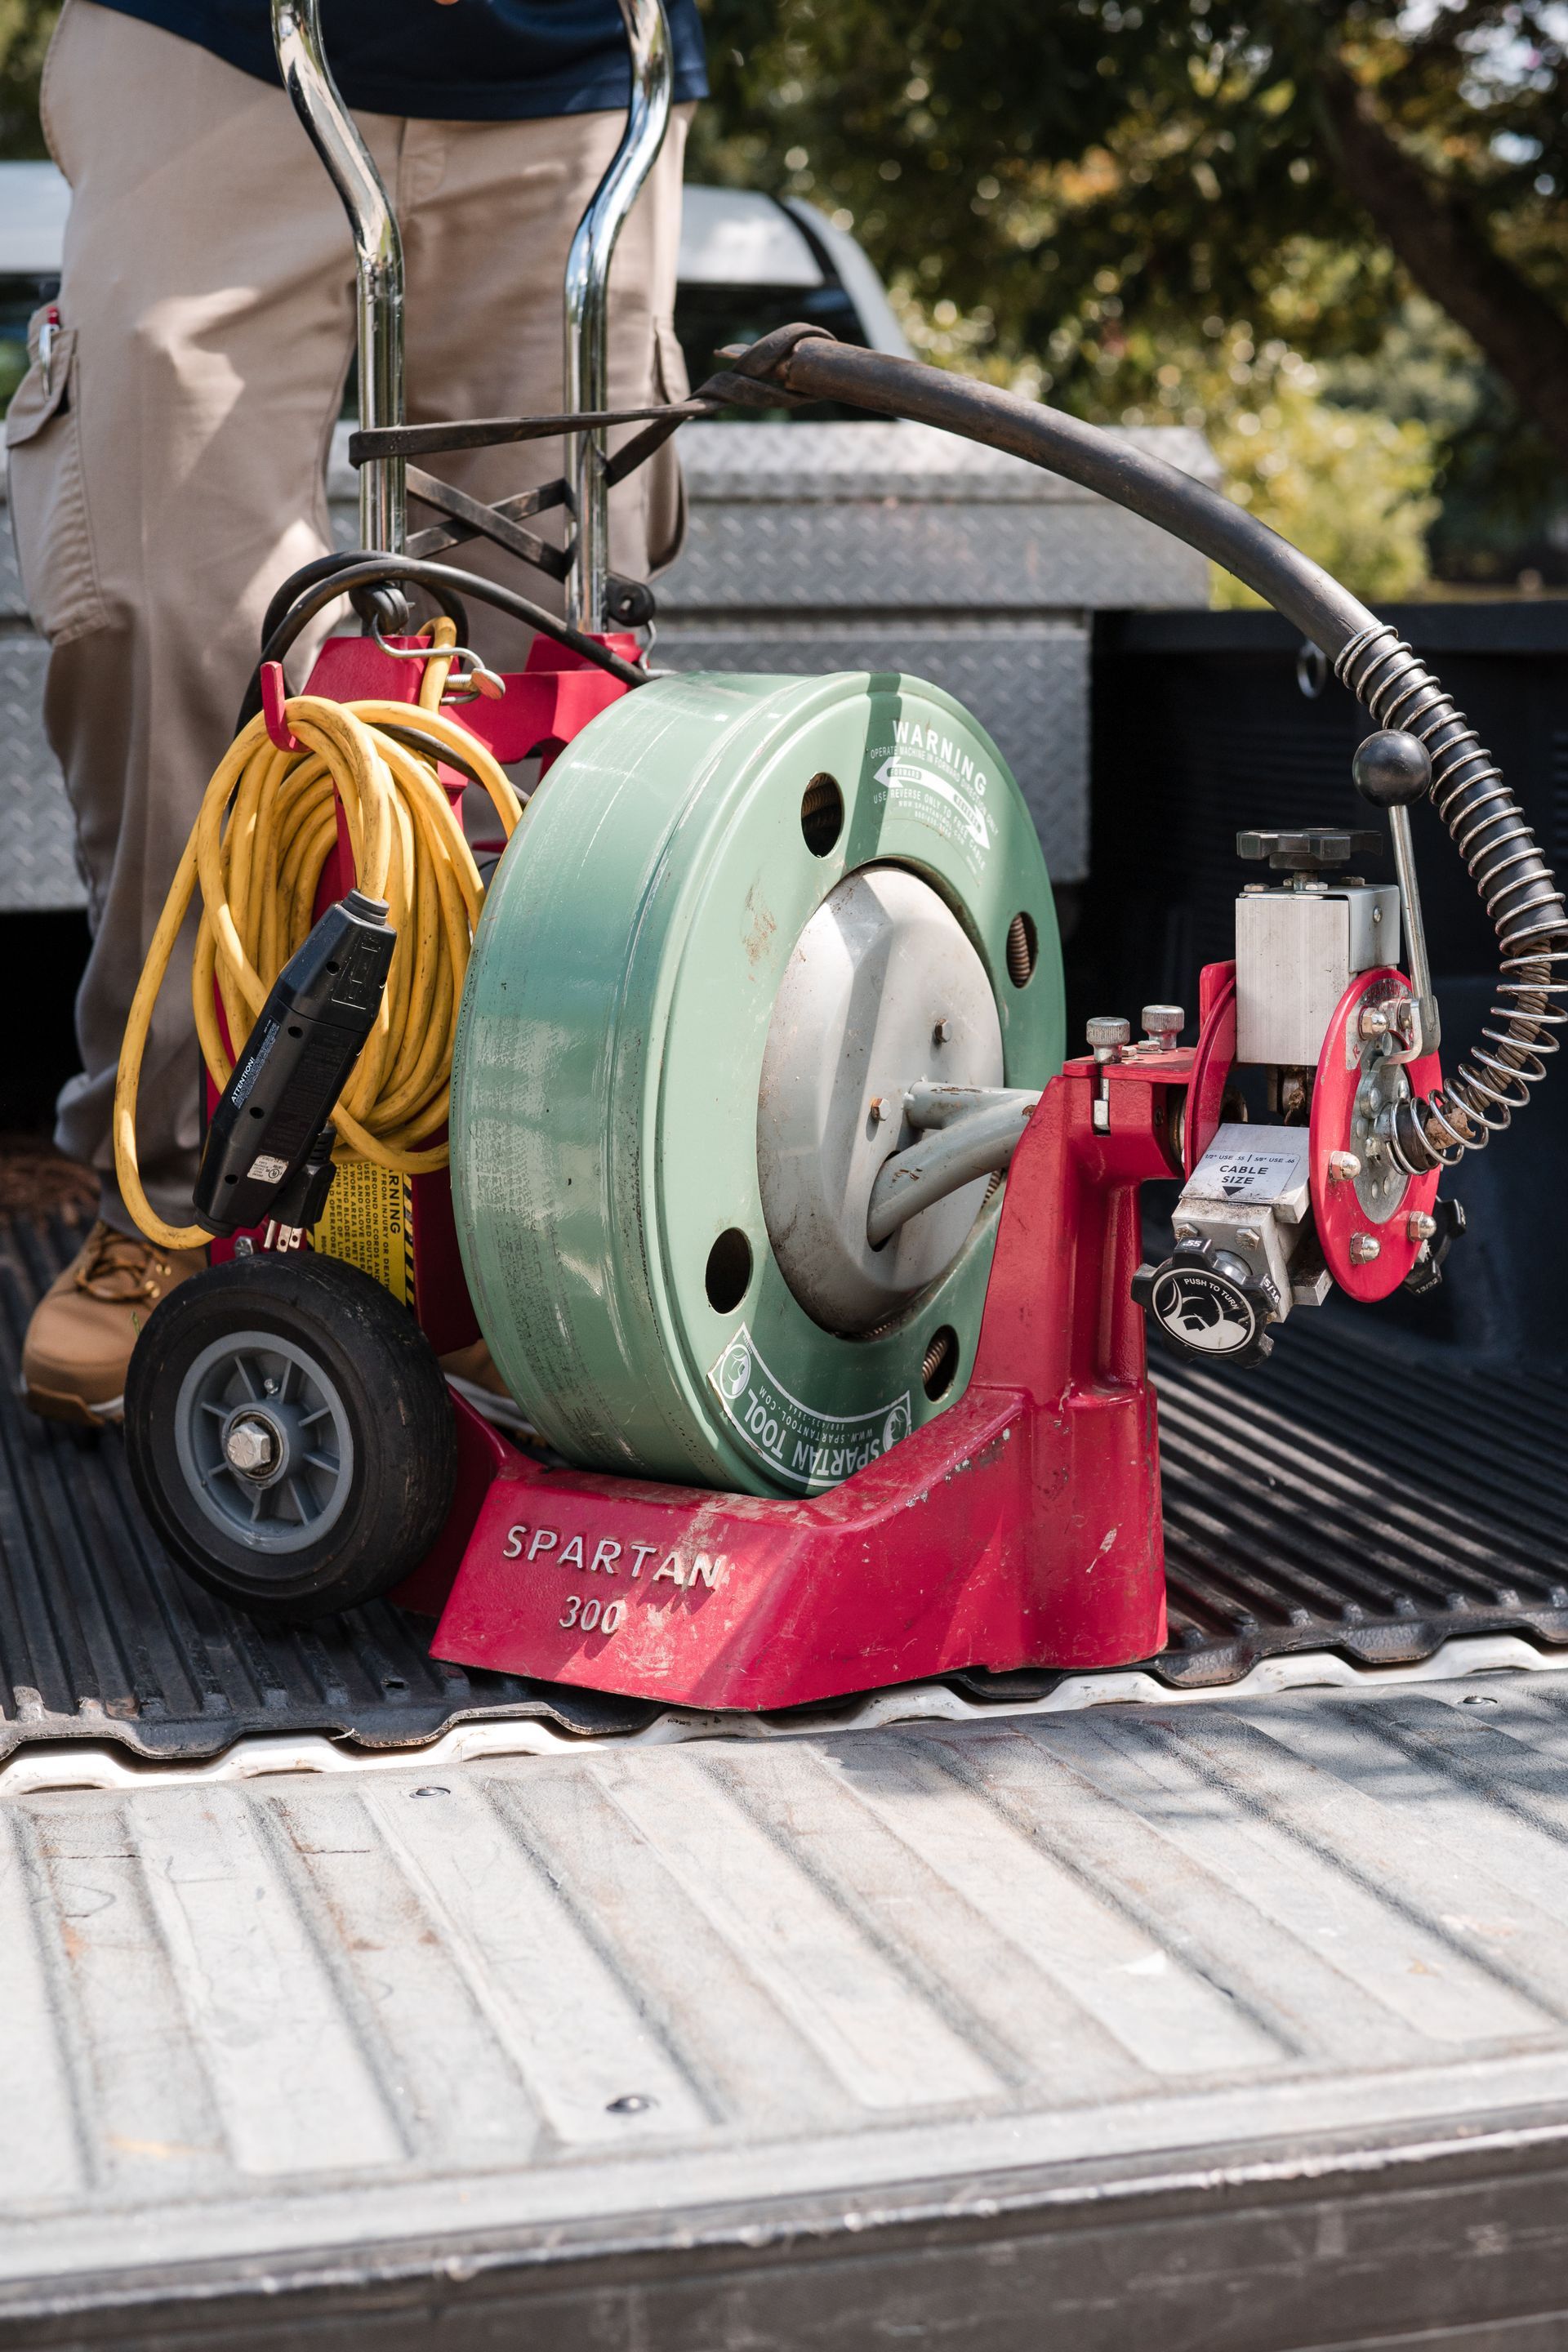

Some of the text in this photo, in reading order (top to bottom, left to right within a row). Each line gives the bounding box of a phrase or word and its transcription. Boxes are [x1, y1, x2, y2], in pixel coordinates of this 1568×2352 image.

[871, 746, 898, 759] OPERATE
[900, 746, 926, 760] MACHINE
[893, 720, 987, 796] WARNING
[890, 768, 920, 780] FORWARD
[873, 791, 887, 804] USE
[890, 788, 921, 800] REVERSE
[924, 793, 941, 810] ONLY
[943, 804, 951, 818] TO
[953, 816, 968, 840] FREE
[231, 1056, 256, 1102] ATTENTION!
[1219, 1165, 1269, 1175] CABLE
[1221, 1175, 1255, 1184] SIZE
[389, 1169, 400, 1234] RNING
[372, 1213, 378, 1225] ON
[337, 1226, 343, 1238] OF
[352, 1230, 357, 1238] IS
[345, 1246, 350, 1258] OR
[383, 1241, 389, 1254] OR
[1184, 1278, 1240, 1310] PUSH TO TURN
[1263, 1278, 1280, 1303] 5/16
[744, 1388, 880, 1476] SPARTAN TOOL
[502, 1525, 727, 1588] SPARTAN
[559, 1596, 626, 1634] 300
